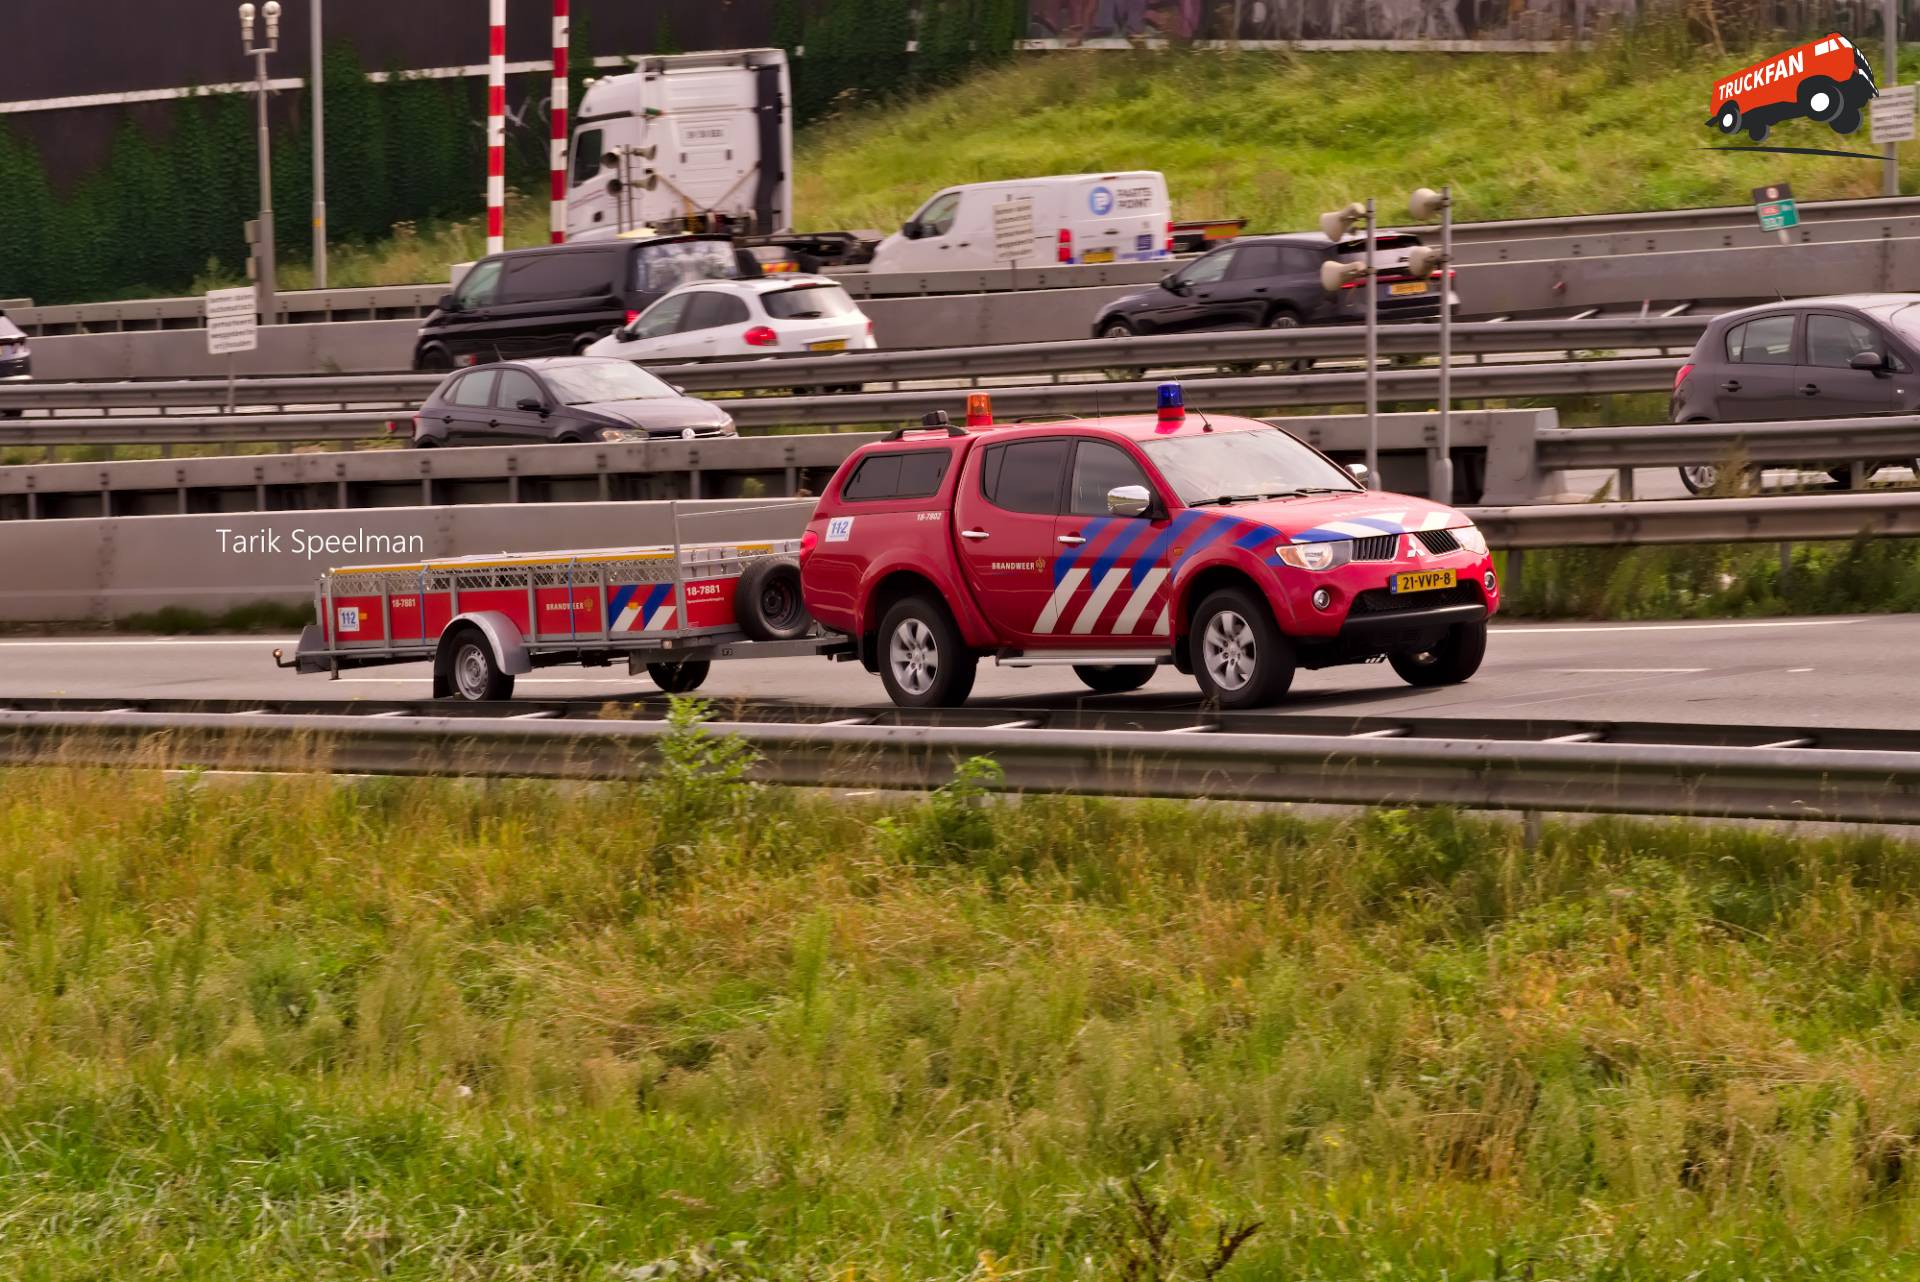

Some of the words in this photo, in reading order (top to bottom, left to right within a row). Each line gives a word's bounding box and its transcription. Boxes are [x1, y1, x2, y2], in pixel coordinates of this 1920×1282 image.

[831, 521, 849, 535] 112
[991, 562, 1035, 570] BRANDWEER
[1403, 572, 1451, 590] 21-VVP-8
[687, 584, 720, 596] 18-7881
[341, 611, 356, 625] 112
